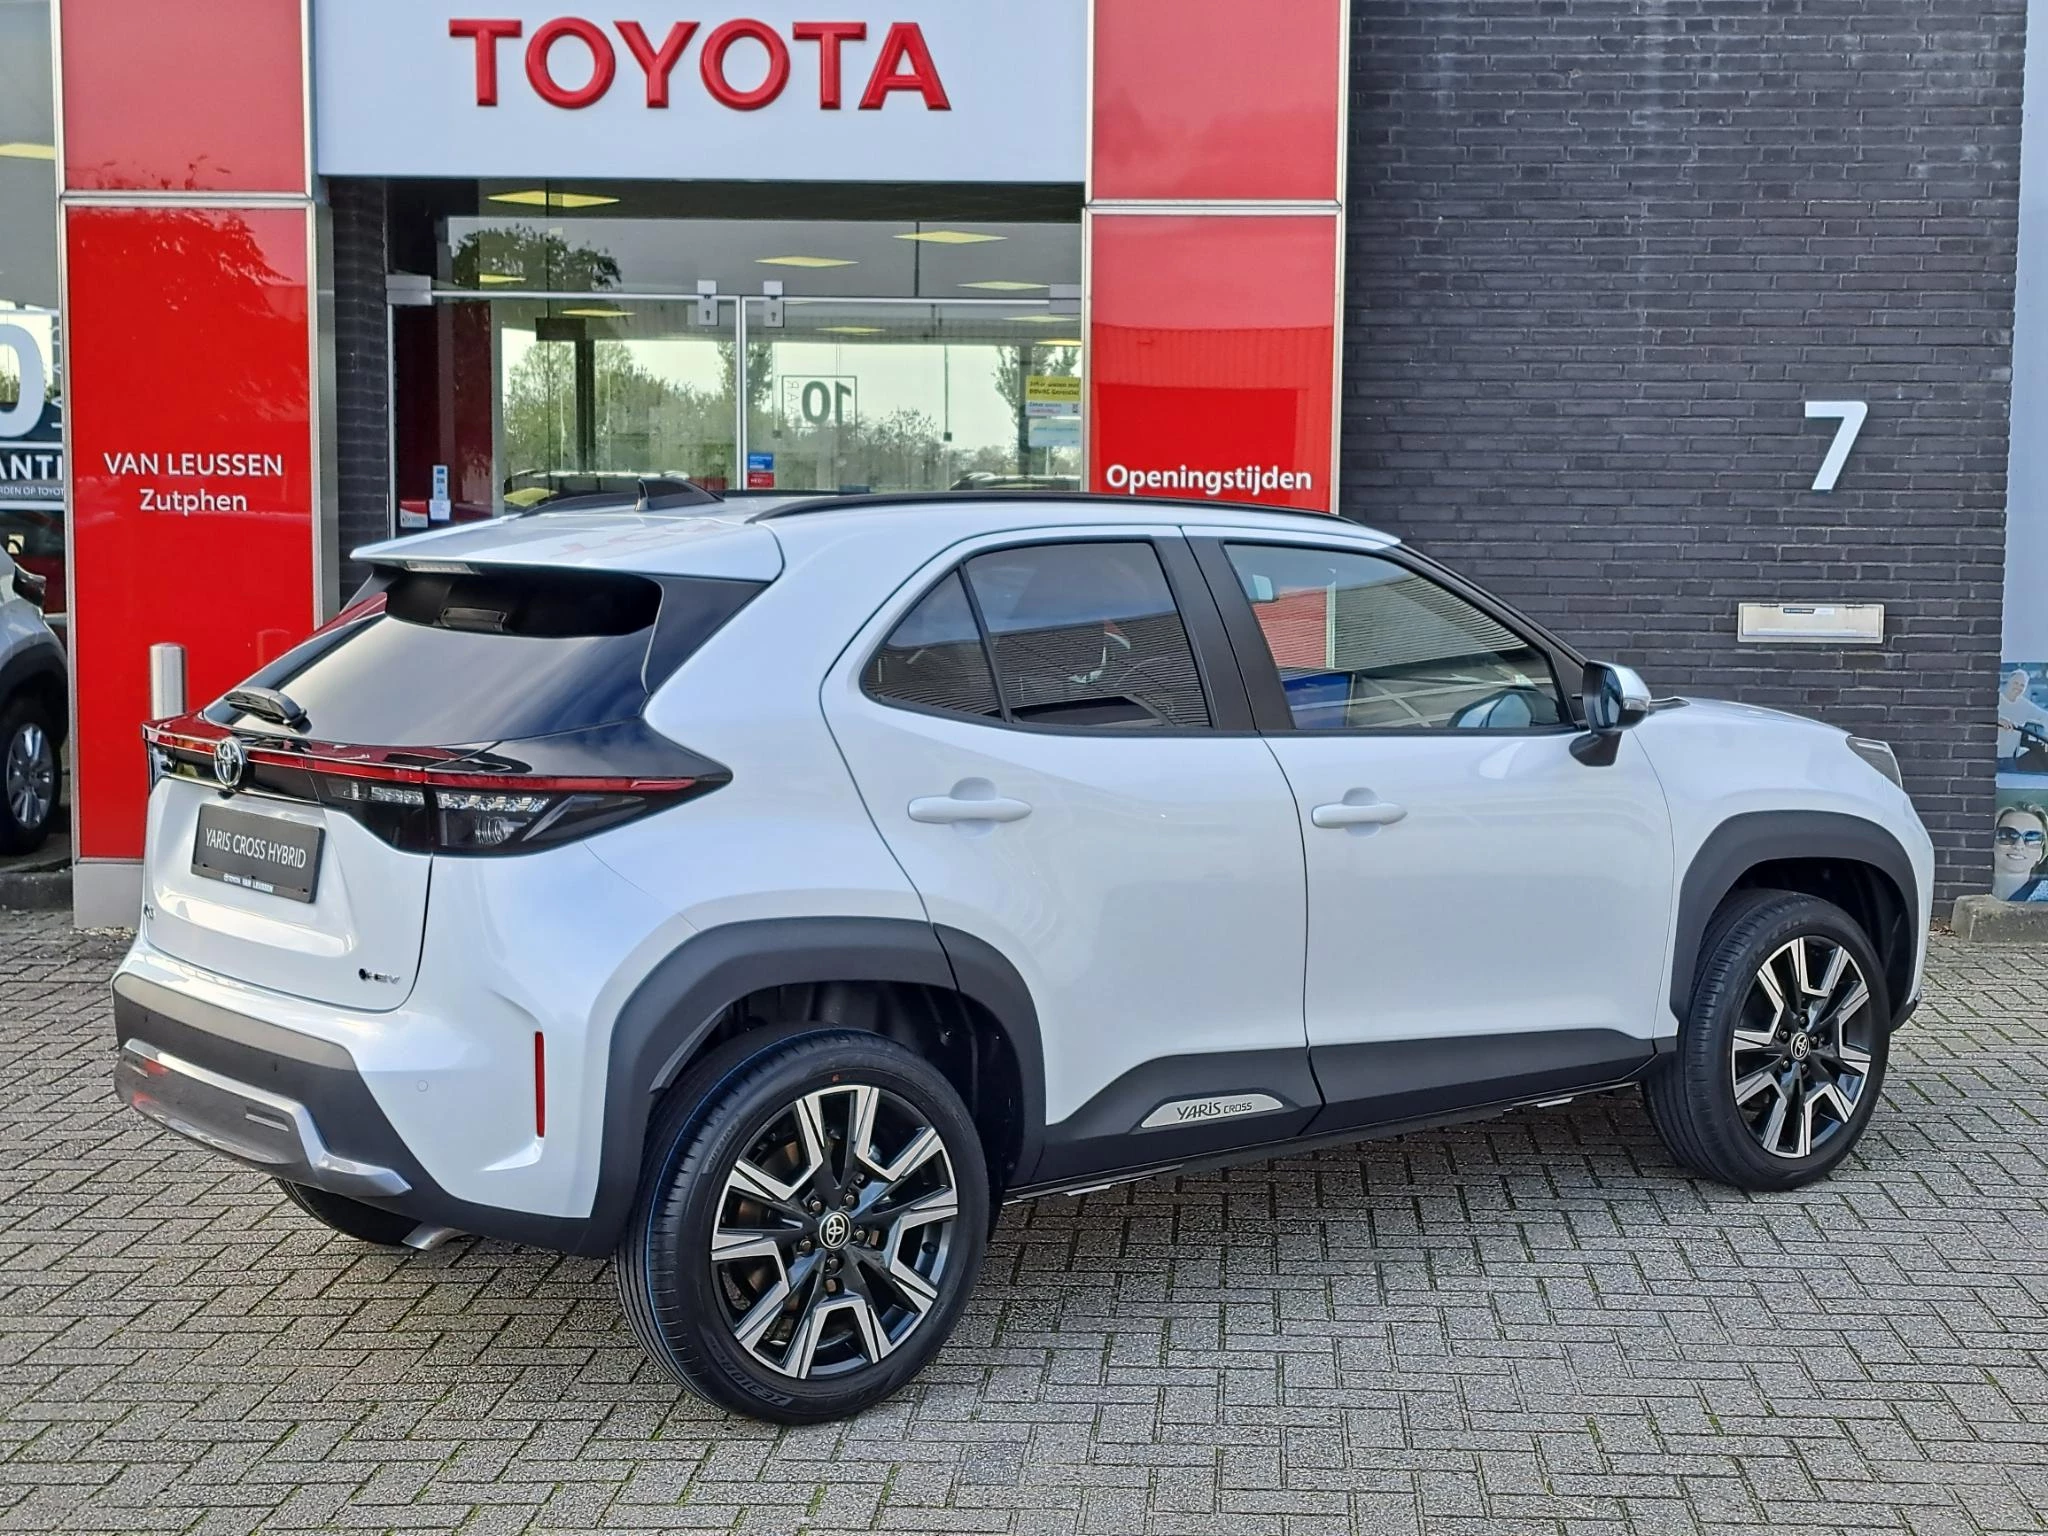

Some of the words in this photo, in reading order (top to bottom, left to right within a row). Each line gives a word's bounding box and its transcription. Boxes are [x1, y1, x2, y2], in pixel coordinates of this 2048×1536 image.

[449, 16, 952, 112] TOYOTA
[1804, 400, 1868, 490] 7
[103, 452, 159, 475] VAN
[167, 453, 283, 477] LEUSSEN
[1106, 464, 1313, 496] Openingstijden
[139, 488, 248, 517] Zutphen
[205, 828, 232, 852] YARIS
[232, 834, 267, 860] CROSS
[267, 841, 307, 869] HYBRID
[1223, 1102, 1253, 1114] CROSS
